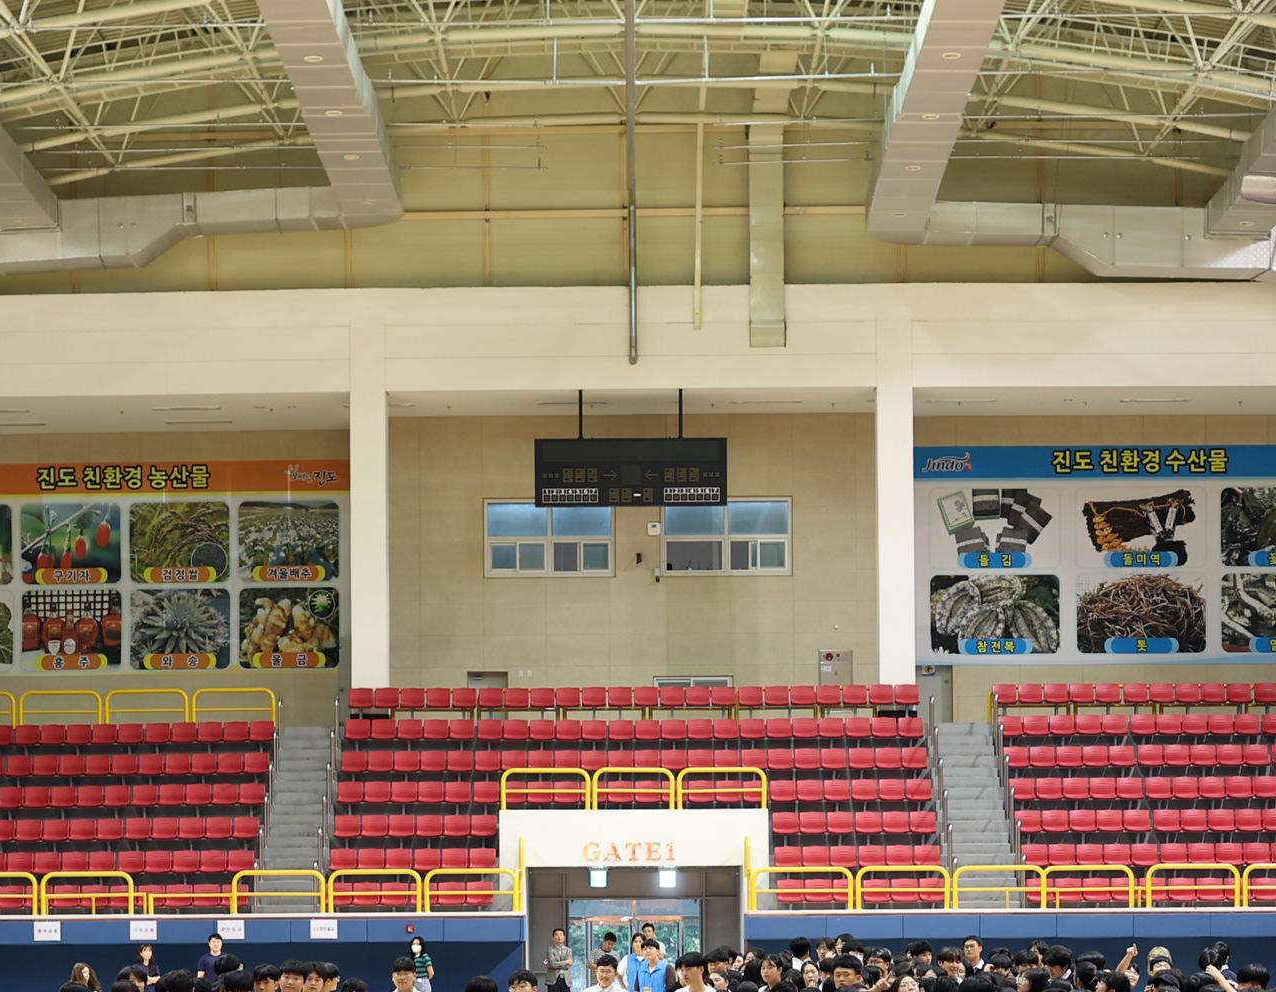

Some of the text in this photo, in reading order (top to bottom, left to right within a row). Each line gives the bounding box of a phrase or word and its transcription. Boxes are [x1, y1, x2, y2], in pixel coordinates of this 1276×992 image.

[1051, 448, 1229, 474] 진도 친환경 수산물
[37, 464, 210, 490] 진도 친환경 농산물
[313, 469, 340, 487] 진도
[1122, 553, 1162, 566] 돌미역
[53, 570, 90, 582] 구기자
[161, 568, 199, 582] 검정쌀
[267, 567, 312, 581] 겨울배추
[977, 640, 1016, 653] 참전복
[1136, 639, 1148, 652] 톳
[583, 841, 676, 862] GATE1
